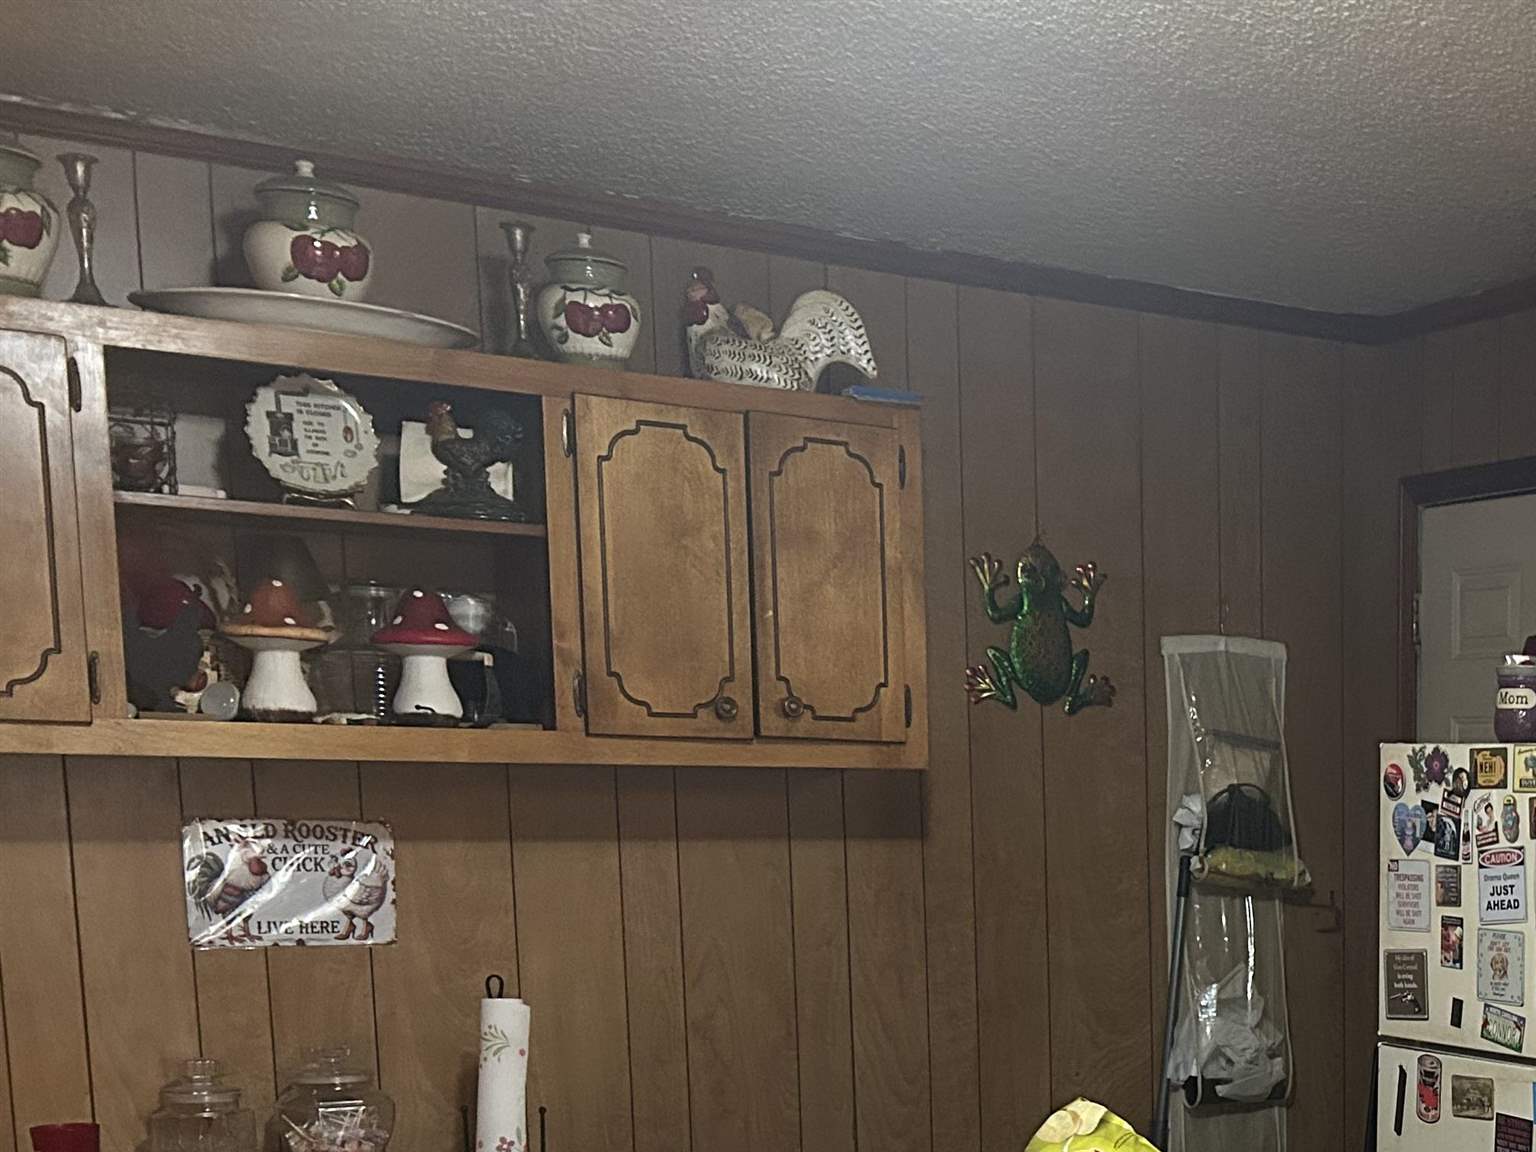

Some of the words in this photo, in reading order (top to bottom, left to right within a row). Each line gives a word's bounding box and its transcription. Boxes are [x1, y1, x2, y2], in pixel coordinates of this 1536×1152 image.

[1499, 690, 1529, 705] Mom
[1479, 761, 1497, 774] NEHI
[283, 822, 379, 855] ROOSTER
[267, 843, 278, 854] &
[280, 843, 290, 854] A
[291, 843, 331, 855] CUTE
[271, 856, 327, 873] CHICK
[1484, 852, 1518, 864] CAUTION
[1489, 884, 1515, 896] JUST
[1486, 898, 1520, 911] AHEAD
[256, 920, 294, 935] LIVE
[298, 920, 341, 935] HERE
